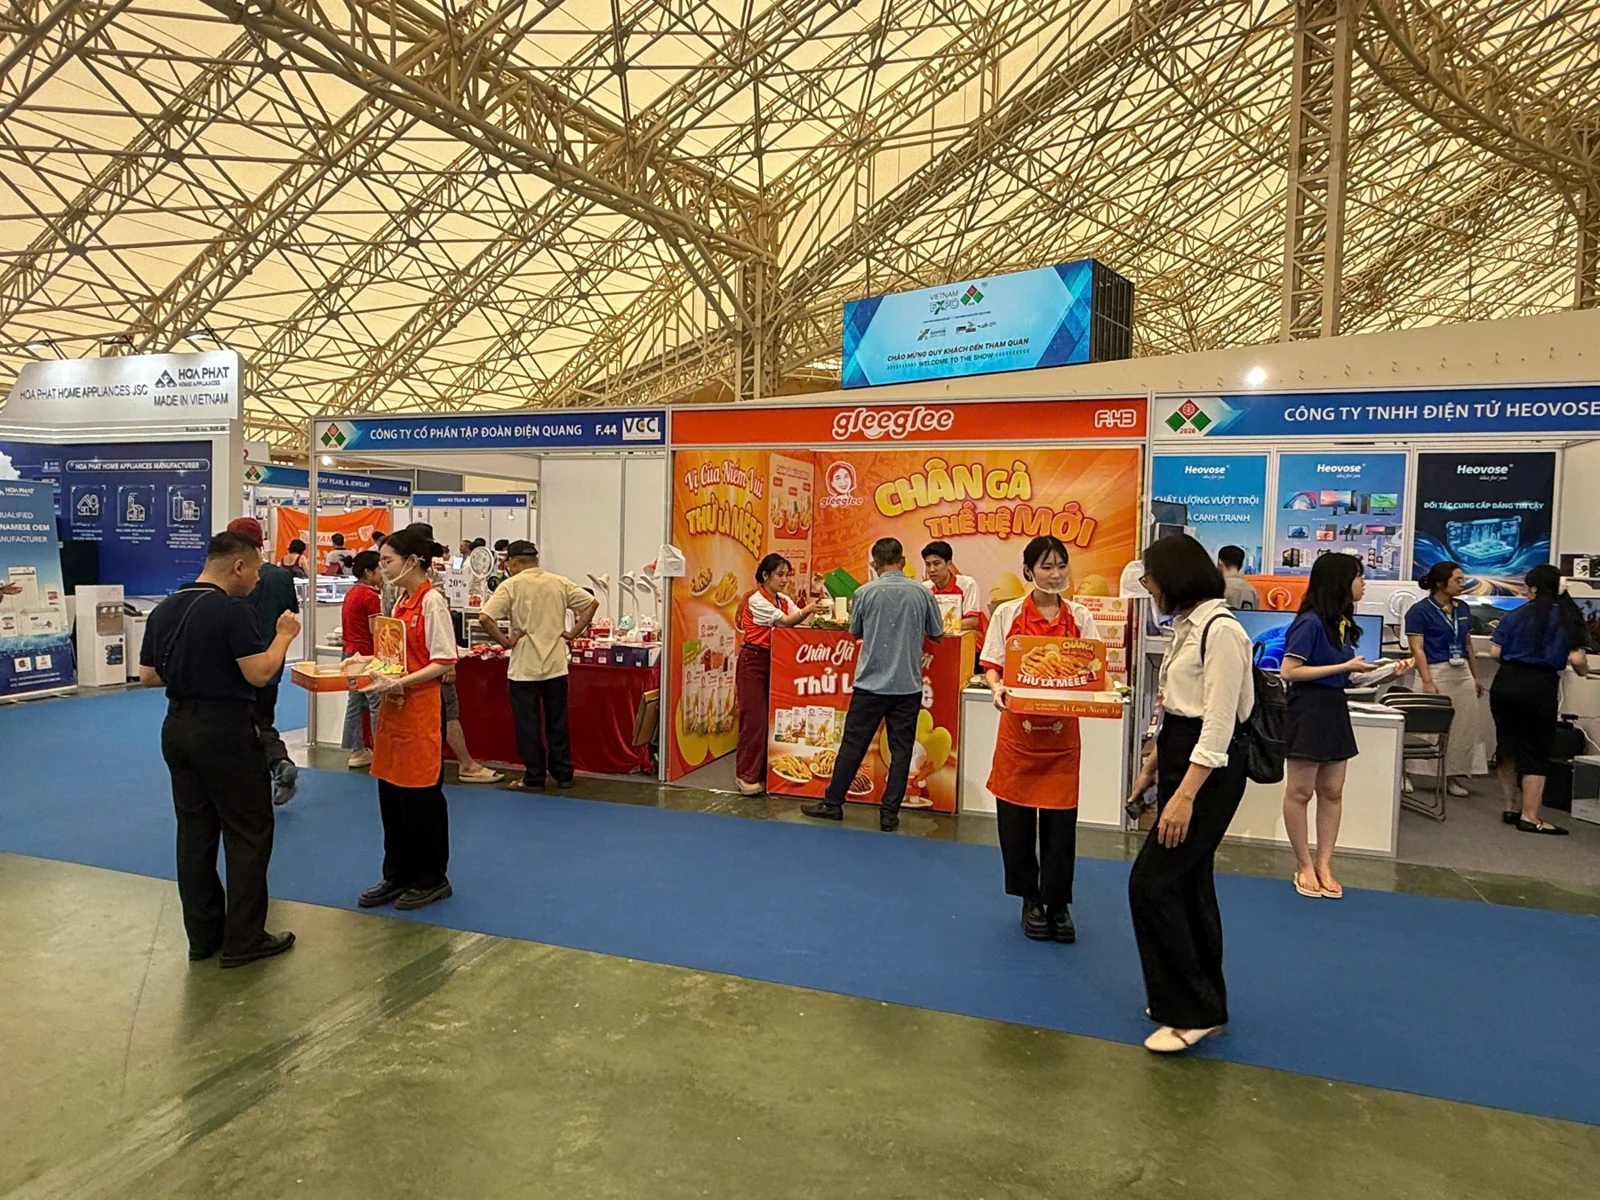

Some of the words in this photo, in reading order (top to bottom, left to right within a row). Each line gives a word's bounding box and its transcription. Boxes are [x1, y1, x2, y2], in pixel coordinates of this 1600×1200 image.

[929, 290, 958, 300] VIETNAM
[929, 298, 959, 315] EXPO
[944, 345, 968, 355] KHÁCH
[969, 342, 984, 352] ĐẾN
[984, 341, 1006, 350] THAM
[1007, 338, 1030, 347] QUAN
[918, 358, 948, 367] WELCOME
[973, 352, 993, 361] SHOW
[20, 389, 35, 400] HOA
[37, 388, 56, 400] PHAT
[58, 386, 81, 399] HOME
[82, 383, 130, 398] APPLIANCES
[132, 383, 149, 396] JSC
[154, 394, 178, 406] MADE
[180, 394, 188, 405] IN
[190, 392, 229, 406] VIETNAM
[1284, 405, 1334, 421] CÔNG
[1339, 406, 1363, 420] TY
[1366, 405, 1418, 420] TNHH
[1423, 402, 1469, 421] ĐIỆN
[1474, 400, 1501, 418] TỬ
[1506, 401, 1600, 417] HEOVOSE
[370, 428, 398, 440] CÔNG
[399, 429, 412, 439] TY
[460, 426, 479, 440] TẬP
[481, 425, 512, 438] ĐOÀN
[514, 424, 539, 439] ĐIỆN
[542, 424, 582, 437] QUANG
[595, 424, 617, 436] F.44
[623, 417, 657, 433] VCC
[832, 406, 954, 440] gleeglee
[1094, 409, 1136, 428] F.43
[120, 462, 153, 470] APPLIANCES
[153, 462, 200, 470] MANUFACTURER
[1184, 465, 1226, 474] Heovose
[1317, 463, 1362, 473] Heovose
[1457, 465, 1508, 474] Heovose
[700, 461, 720, 487] Của
[329, 477, 346, 487] PEARL
[875, 457, 984, 517] CHÂN
[985, 459, 1032, 501] GÀ
[820, 496, 863, 508] gleeglee
[1179, 494, 1210, 506] LƯỢNG
[1211, 495, 1236, 506] VƯỢT
[1237, 494, 1259, 506] TRỘI
[718, 500, 731, 537] LÀ
[978, 506, 1013, 539] HỆ
[1012, 501, 1098, 548] MỚI
[1219, 514, 1250, 522] TRANH
[448, 578, 467, 588] 20%
[796, 642, 831, 663] Chân
